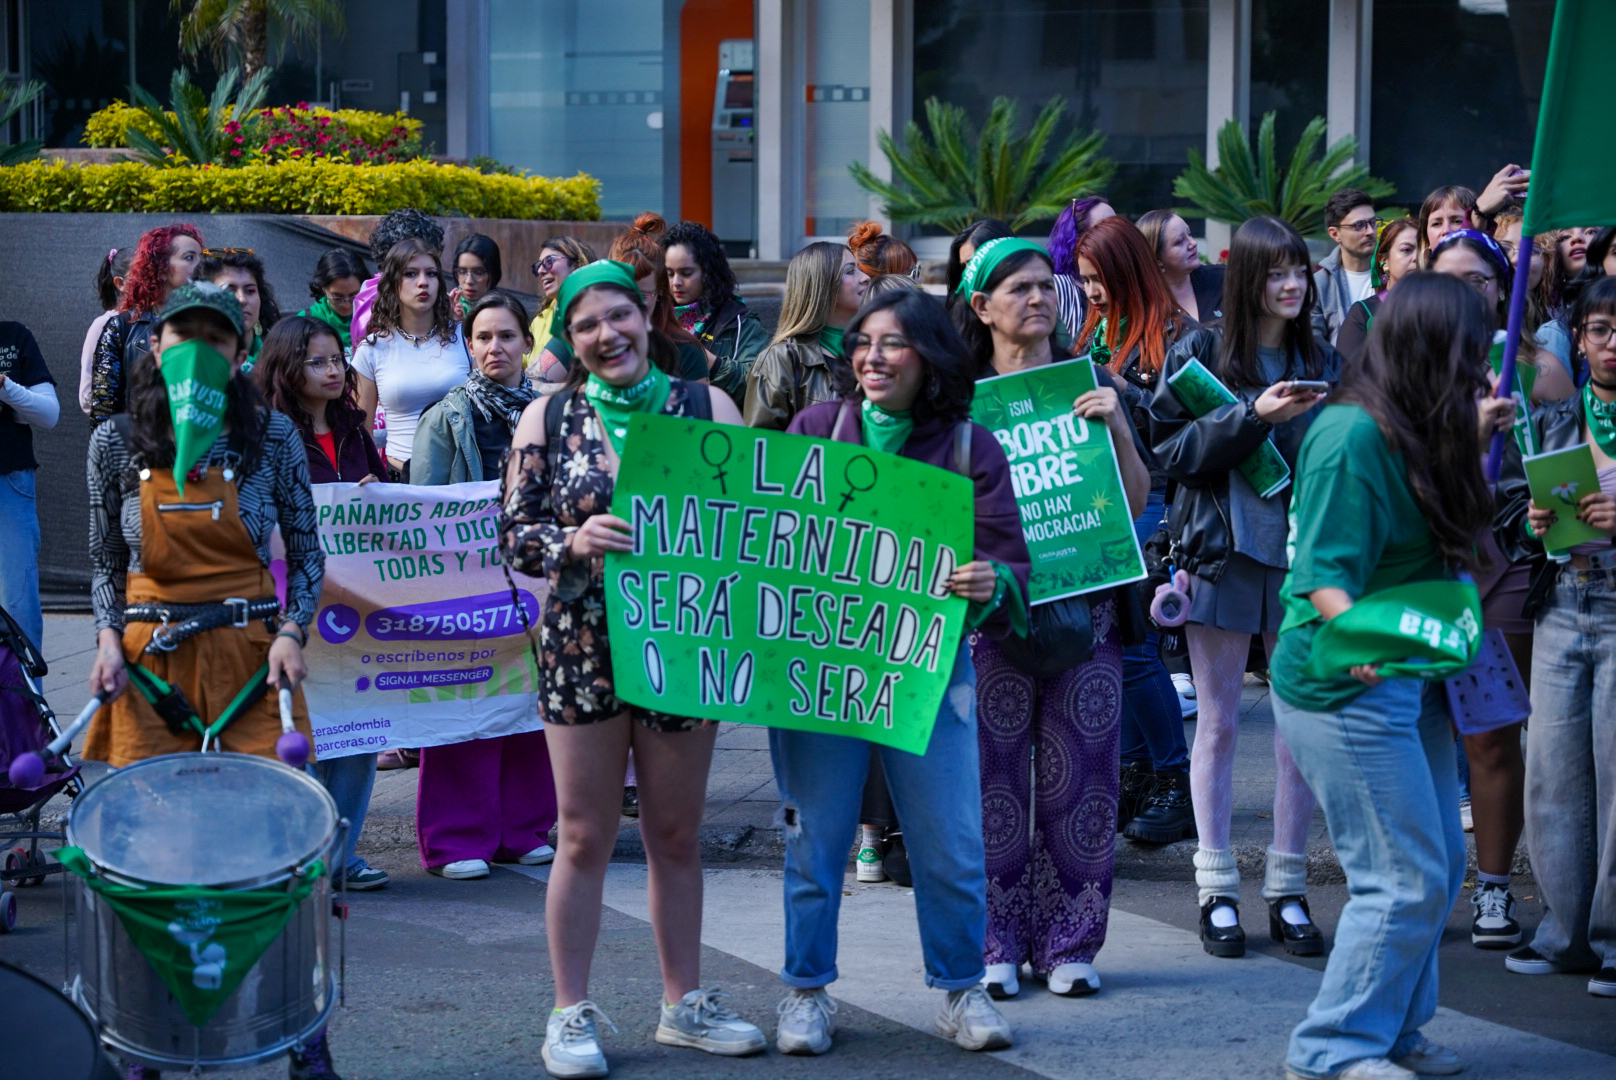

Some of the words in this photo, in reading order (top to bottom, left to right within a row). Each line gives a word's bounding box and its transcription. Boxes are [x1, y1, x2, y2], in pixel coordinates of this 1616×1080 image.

[1008, 398, 1034, 417] ¡SIN
[993, 410, 1089, 462] BORTO
[753, 438, 825, 504] LA
[429, 498, 501, 519] ABORT
[1020, 501, 1042, 523] NO
[1044, 493, 1072, 516] HAY
[322, 527, 427, 555] LIBERTAD
[433, 524, 447, 547] Y
[1022, 509, 1101, 543] MOCRACIA!
[631, 495, 957, 600] MATERNIDAD
[373, 553, 445, 581] TODAS
[455, 550, 468, 572] Y
[376, 602, 530, 636] 3187505775
[618, 571, 741, 639] SERÁ
[757, 582, 946, 672] DESEADA
[361, 654, 371, 664] o
[376, 649, 465, 663] escríbenos
[470, 648, 497, 662] por
[379, 675, 420, 687] SIGNAL
[422, 669, 490, 684] MESSENGER
[643, 637, 665, 696] O
[699, 647, 754, 706] NO
[788, 658, 903, 729] SERÁ
[312, 718, 391, 738] cerascolombia
